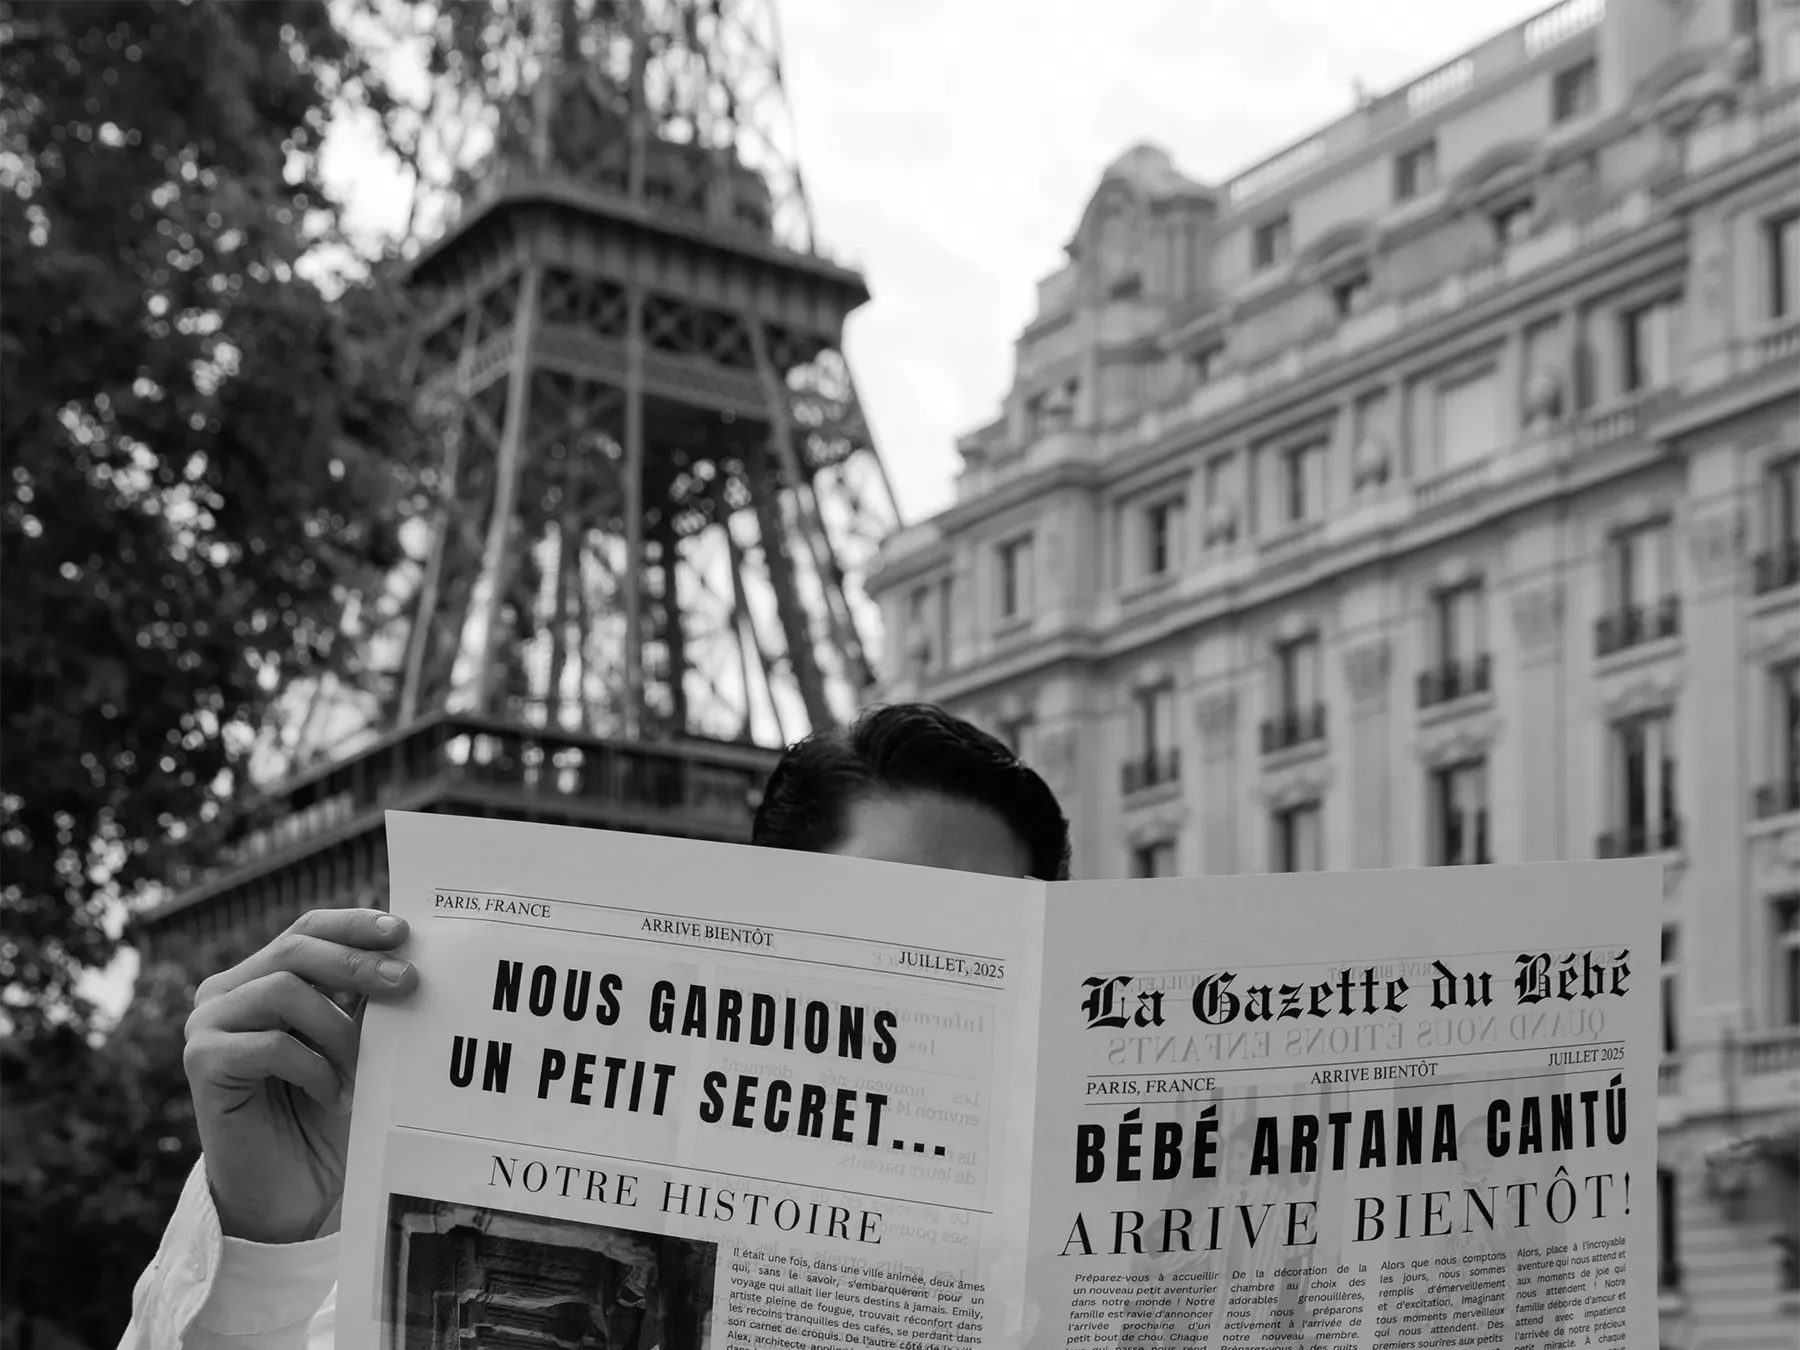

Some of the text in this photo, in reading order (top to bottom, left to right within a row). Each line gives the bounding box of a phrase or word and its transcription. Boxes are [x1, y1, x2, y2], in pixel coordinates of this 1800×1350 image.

[434, 894, 551, 918] PARIS, FRANCE
[640, 918, 775, 946] ARRIVE BIENTÔT
[898, 951, 1005, 979] JUILLET, 2025
[1080, 948, 1631, 1031] La Gazette du Bébé
[492, 959, 899, 1064] NOUS GARDIONS
[1547, 1047, 1625, 1066] JUILLET 2025
[1310, 1060, 1438, 1085] ARRIVE BIENTÔT
[448, 1035, 947, 1156] UN PETIT SECRET...
[1085, 1077, 1216, 1096] PARIS, FRANCE
[1074, 1073, 1628, 1184] BÉBÉ ARTANA CANTÚ
[488, 1155, 884, 1244] NOTRE HISTOIRE
[1057, 1165, 1631, 1257] ARRIVE BIENTÔT!
[1516, 1236, 1626, 1257] Alors, place à l'incroyable
[732, 1246, 985, 1291] Il était une fois, dans une ville animée, deux âmes
[1379, 1251, 1506, 1269] Alors que nous comptons
[1516, 1248, 1626, 1270] aventure qui nous attend et
[1074, 1270, 1219, 1284] Préparez-vous à accueillir
[1231, 1263, 1349, 1279] De la décoration de
[1379, 1266, 1506, 1284] les jours, nous sommes
[731, 1262, 984, 1305] qui, sans le savoir, s'embarquèrent pour un
[1072, 1283, 1217, 1297] un nouveau petit aventurier
[1229, 1279, 1337, 1292] chambre au choix
[1378, 1277, 1506, 1299] remplis d'émerveillement
[1223, 1317, 1342, 1329] activement à l'arrivée
